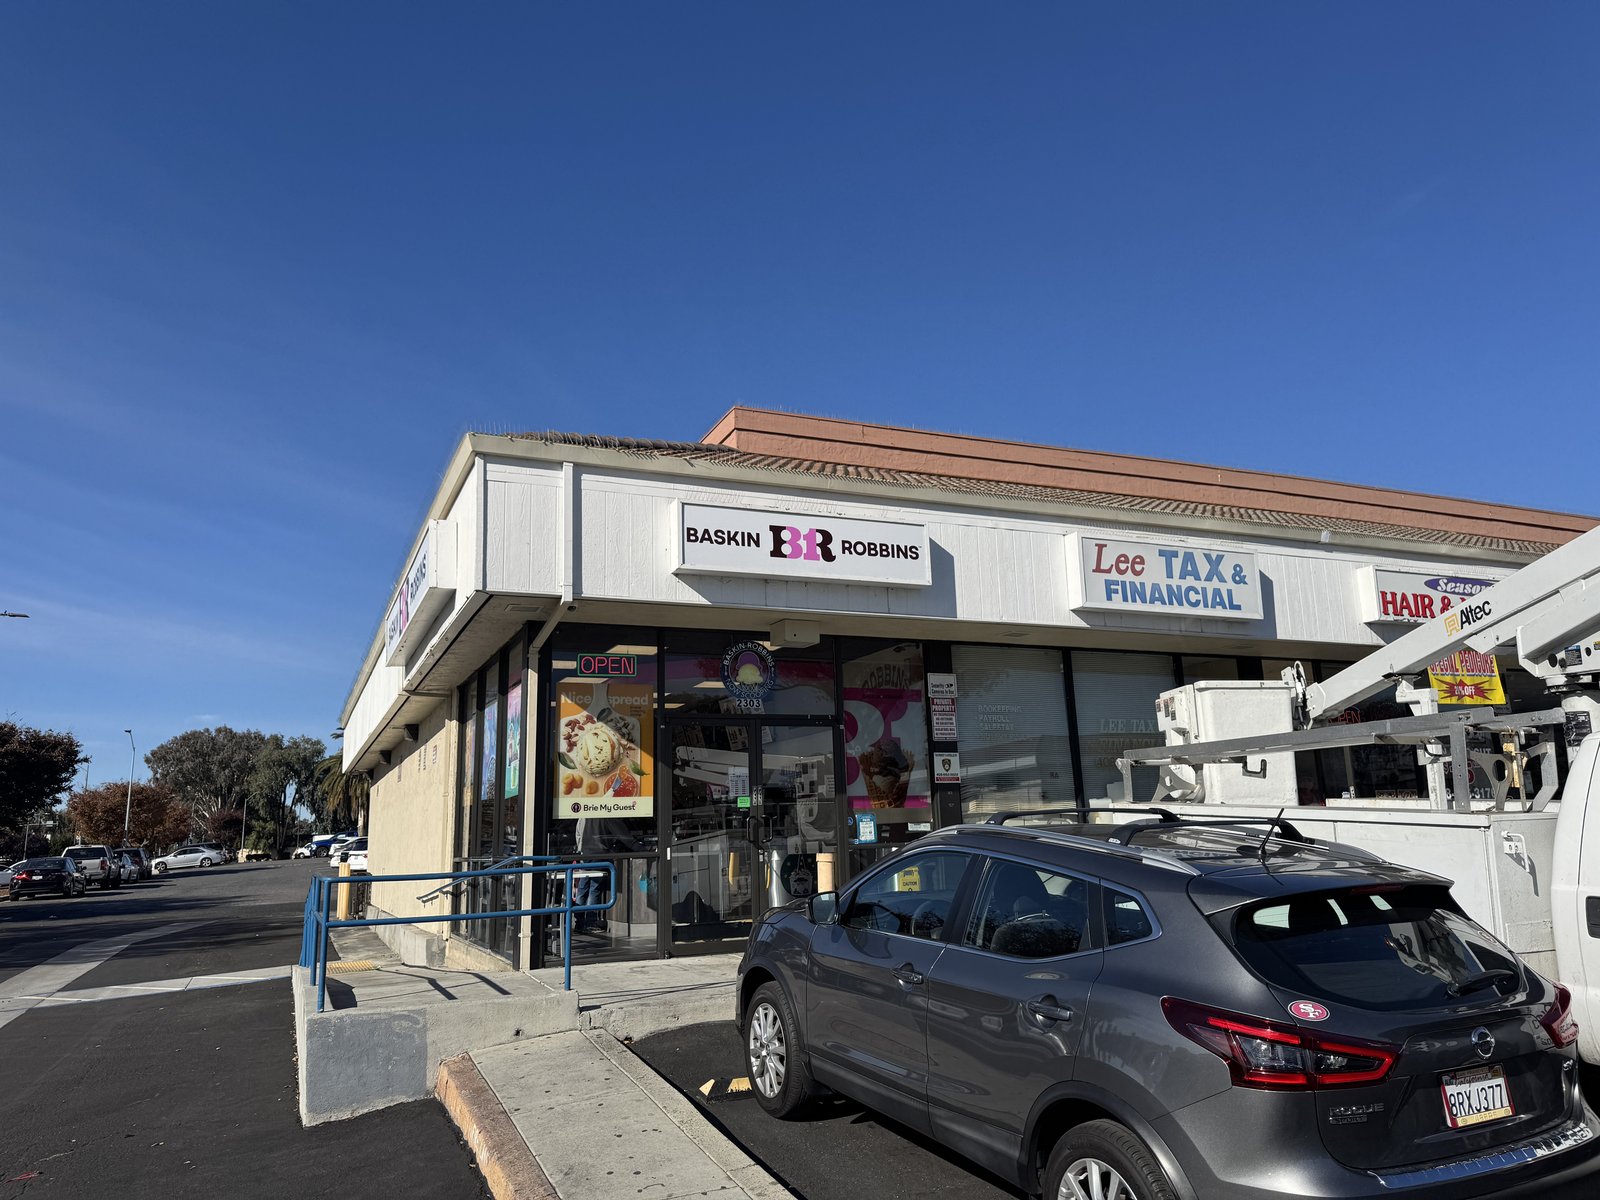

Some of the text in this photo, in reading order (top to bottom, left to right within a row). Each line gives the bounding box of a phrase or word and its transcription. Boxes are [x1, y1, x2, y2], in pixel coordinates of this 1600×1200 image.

[686, 527, 760, 548] BASKIN
[841, 540, 920, 560] ROBBINS
[1092, 543, 1248, 585] Lee TAX &
[1104, 579, 1242, 611] FINANCIAL
[1380, 591, 1436, 619] HAIR
[1460, 600, 1492, 630] Altec
[581, 656, 634, 674] OPEN
[561, 690, 592, 704] Nice
[737, 699, 761, 708] 2303
[583, 803, 636, 812] Brie My Guest
[1449, 1084, 1505, 1117] 8RXJ377
